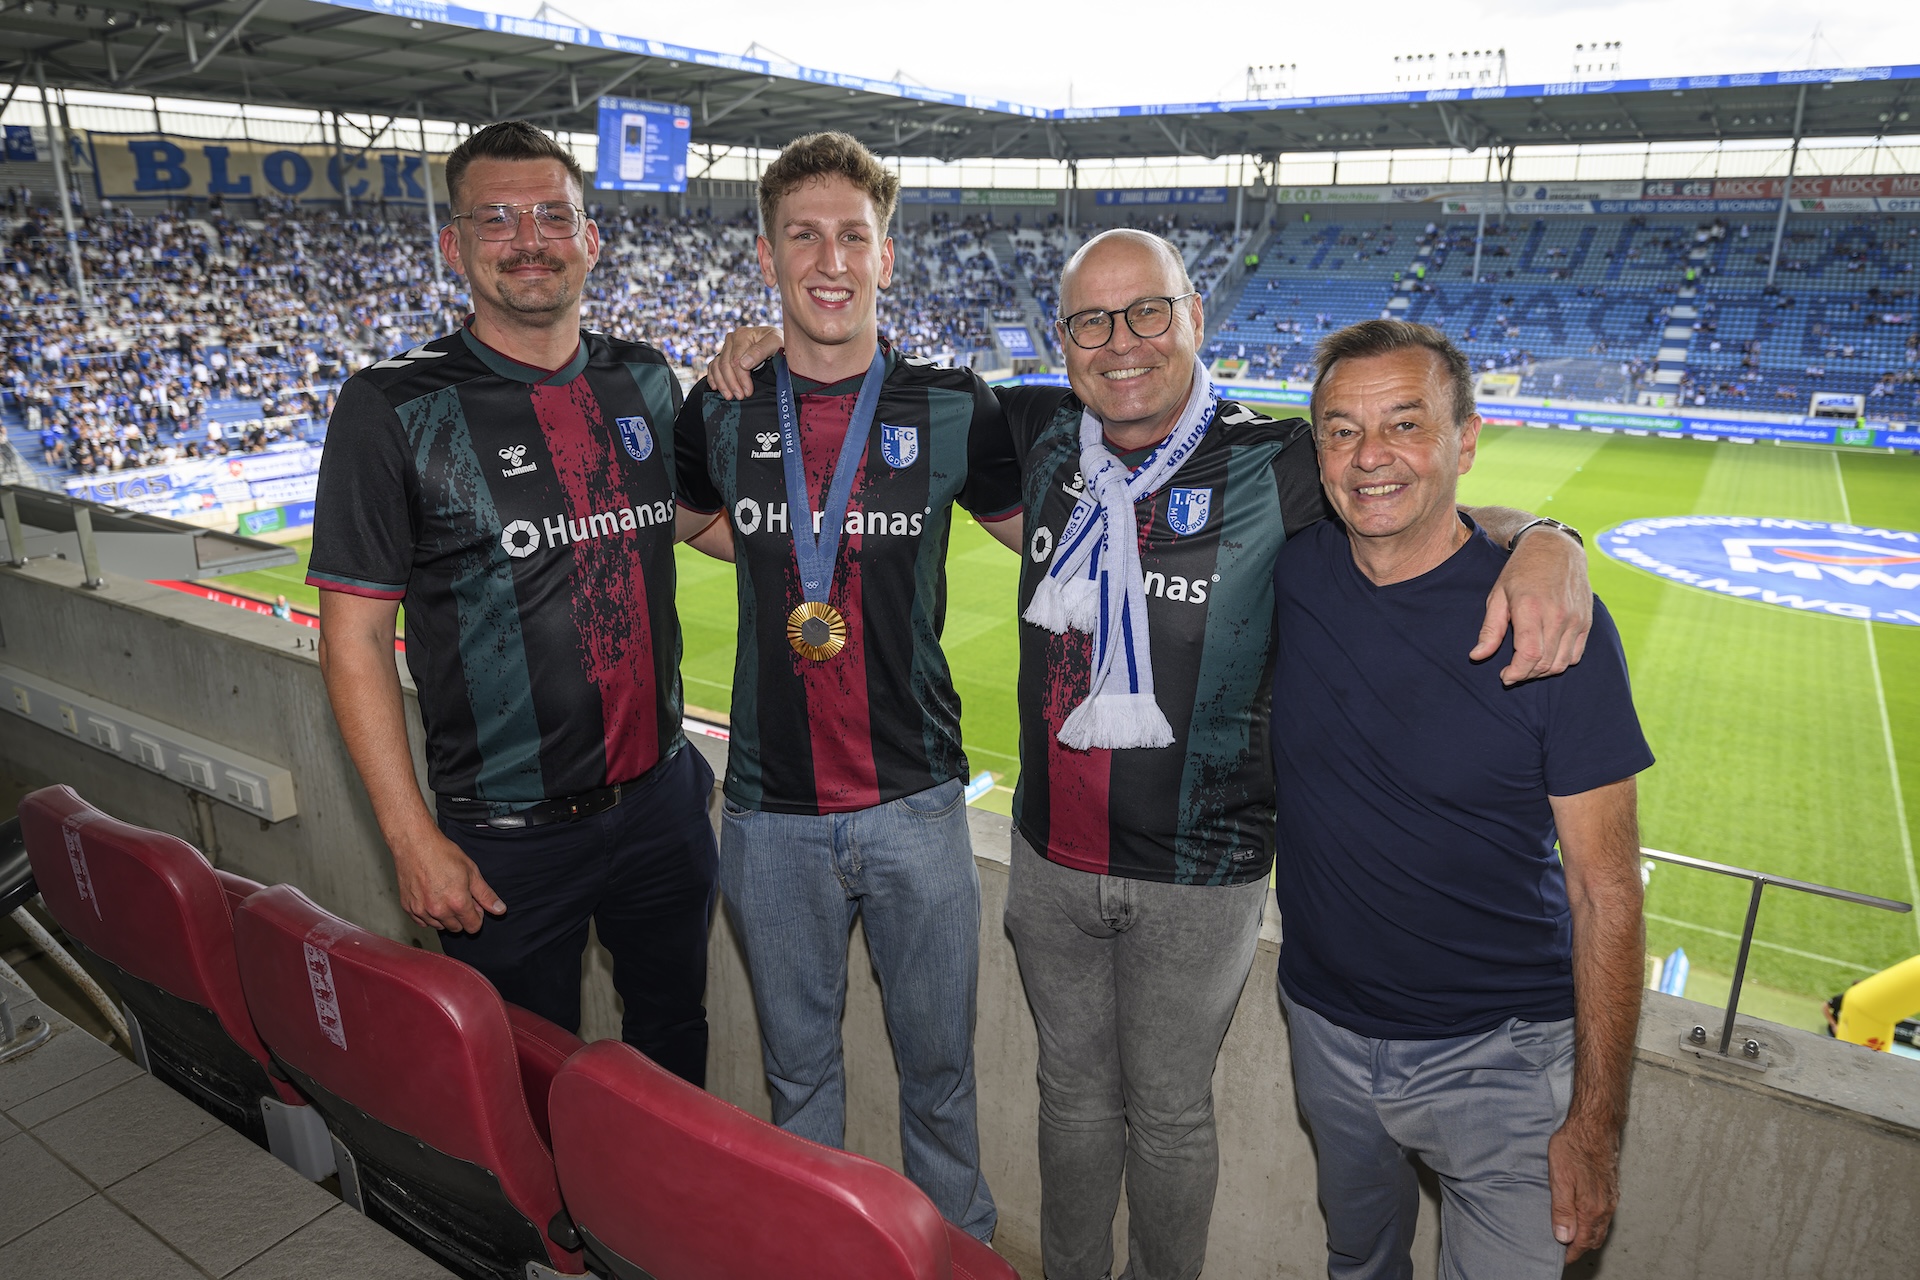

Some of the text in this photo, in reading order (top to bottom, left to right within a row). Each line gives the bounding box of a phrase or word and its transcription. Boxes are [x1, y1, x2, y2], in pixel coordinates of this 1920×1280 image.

[128, 139, 425, 199] BLOCK
[1714, 181, 1766, 195] MDCC
[1830, 179, 1885, 193] MDCC
[781, 390, 794, 454] PARIS 2024
[751, 450, 781, 460] hummel
[884, 443, 917, 465] MAGDEBURG
[502, 462, 537, 478] hummel
[543, 498, 674, 549] Humanas
[1170, 507, 1207, 531] MAGDEBURG
